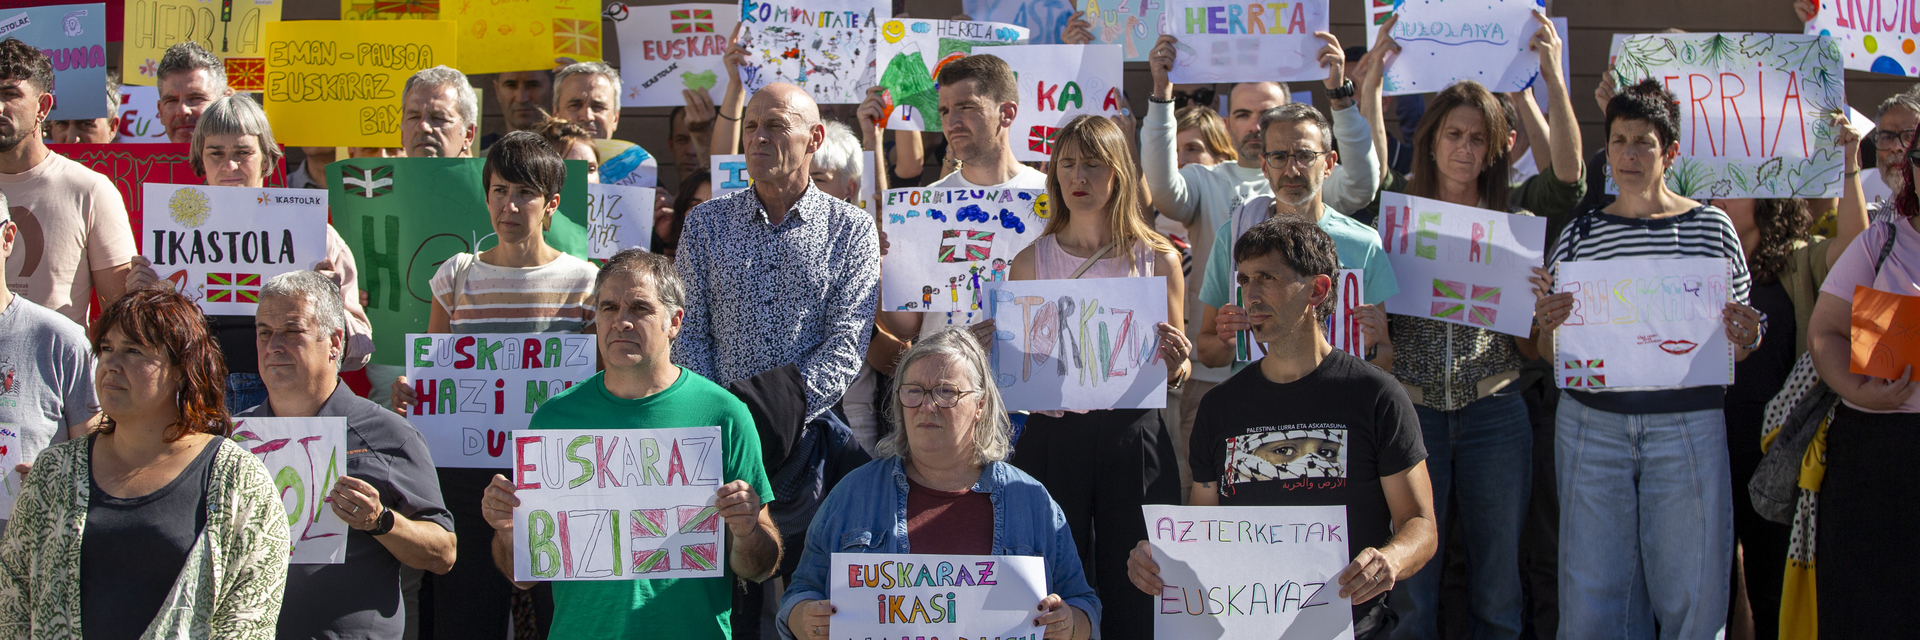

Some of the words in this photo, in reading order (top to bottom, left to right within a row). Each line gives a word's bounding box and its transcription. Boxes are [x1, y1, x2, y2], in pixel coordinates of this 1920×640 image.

[937, 20, 992, 40] HERRIA
[1186, 3, 1306, 34] HERRIA
[41, 44, 105, 71] UNA
[267, 72, 396, 103] EUSKARAZ
[275, 195, 321, 206] IKASTOLAK
[887, 189, 1013, 206] ETORKIZUNA
[153, 229, 296, 265] IKASTOLA
[414, 336, 589, 370] EUSKARAZ
[515, 435, 719, 490] EUSKARAZ
[529, 509, 622, 579] BIZI
[1156, 515, 1343, 544] AZTERKETAK
[848, 561, 998, 589] EUSKARAZ
